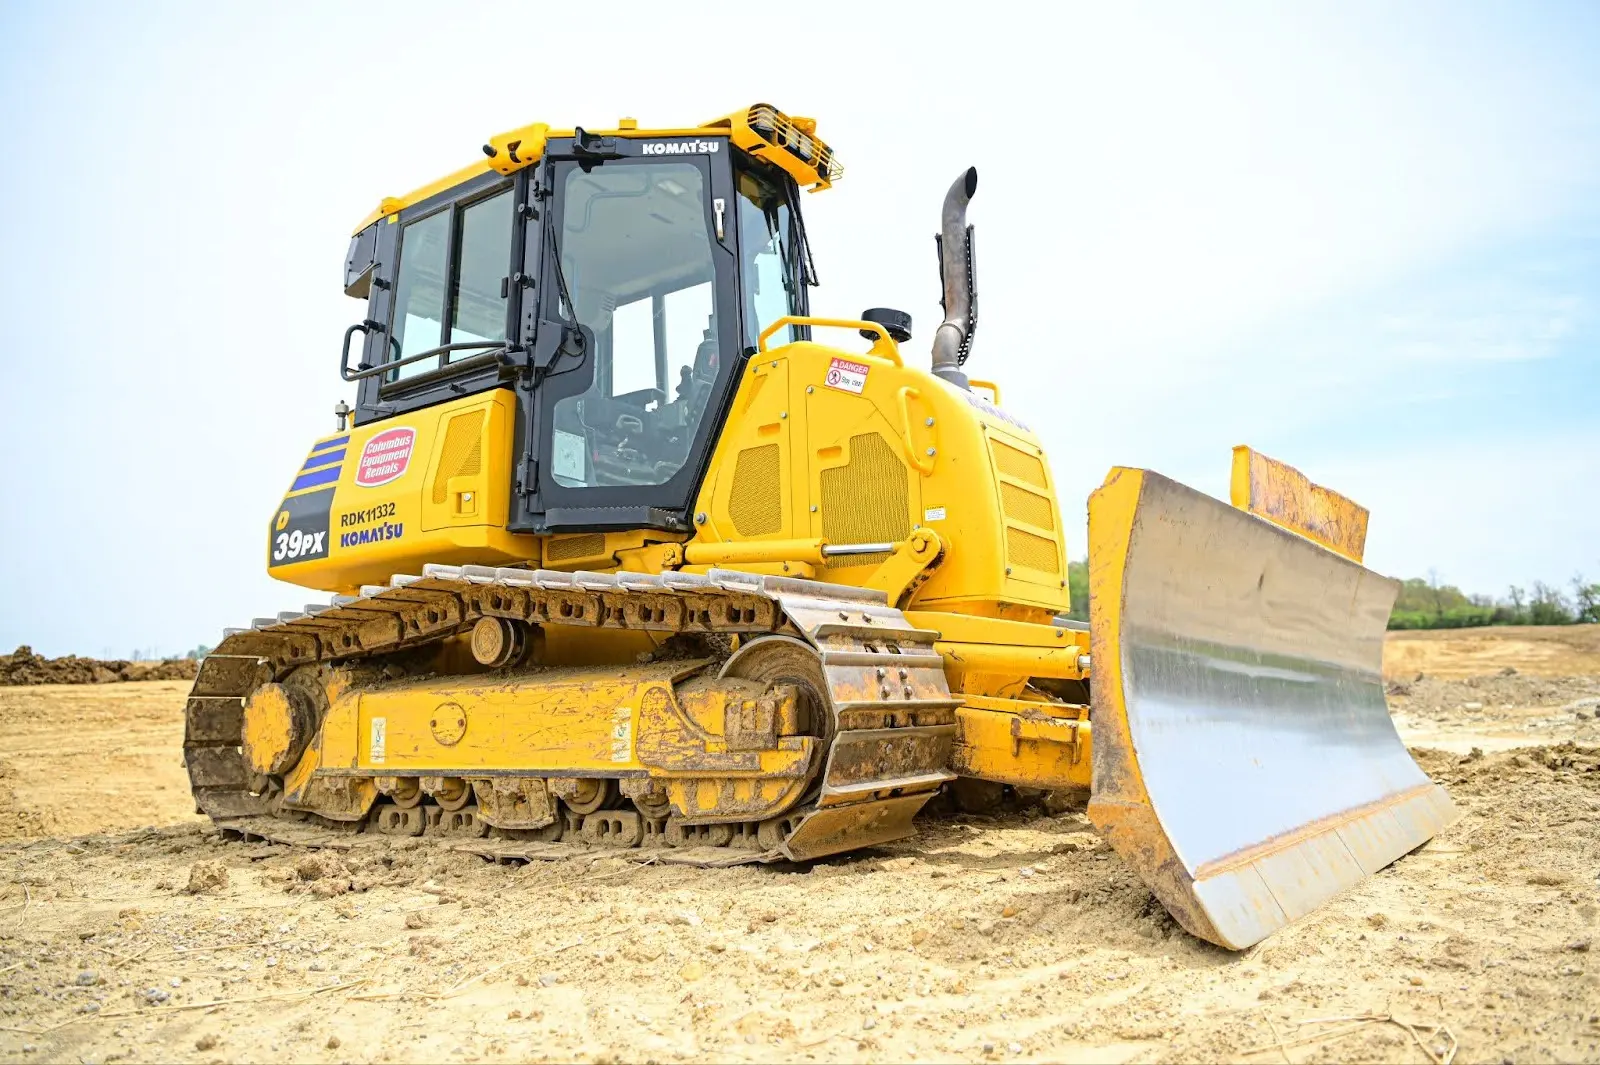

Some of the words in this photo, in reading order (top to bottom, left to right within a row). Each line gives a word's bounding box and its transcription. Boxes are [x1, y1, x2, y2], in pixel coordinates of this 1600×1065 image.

[642, 139, 719, 155] KOMATSU
[839, 361, 868, 374] DANGER
[367, 436, 411, 454] Columbus
[362, 447, 410, 467] Equipment
[364, 462, 399, 479] Rentals
[341, 502, 396, 527] RDK11332
[340, 522, 403, 548] KOMATSU
[273, 529, 327, 561] 39PX
